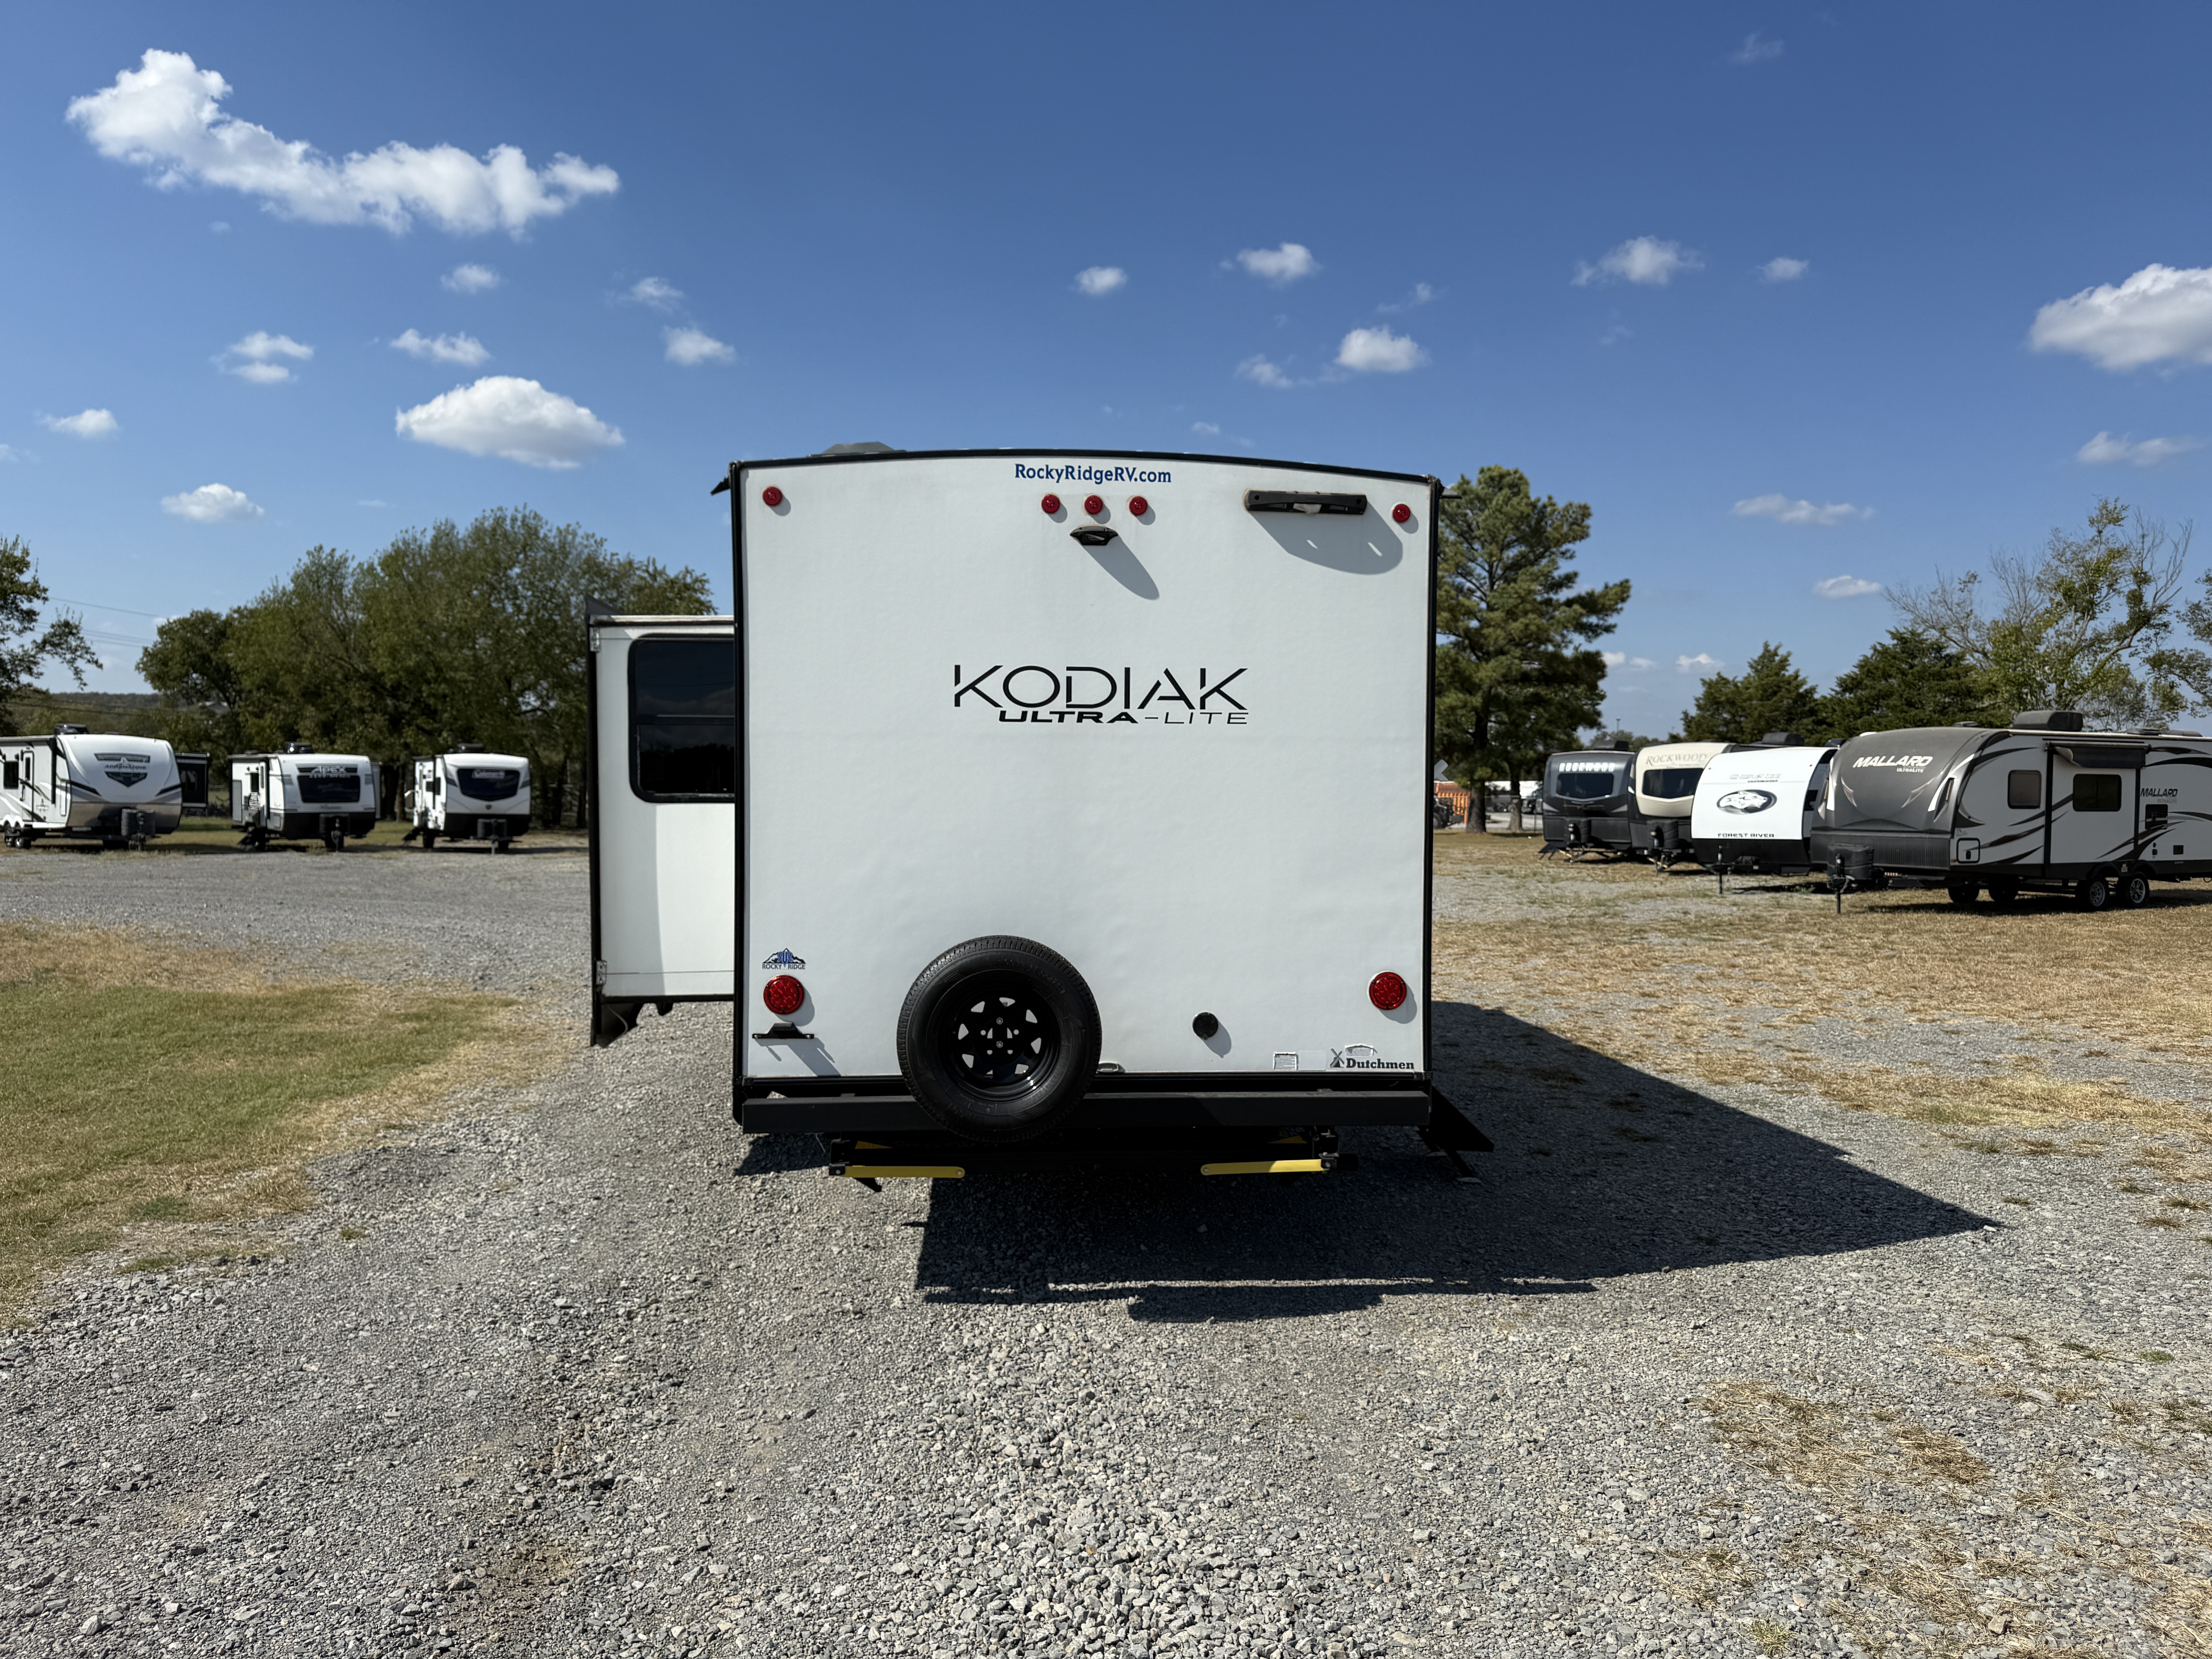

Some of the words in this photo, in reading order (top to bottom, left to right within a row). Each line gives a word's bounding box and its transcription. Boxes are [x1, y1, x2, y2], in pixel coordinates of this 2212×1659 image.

[1015, 464, 1171, 484] RockyRidgeRV.com
[955, 665, 1248, 710] KODIAK
[999, 710, 1249, 724] ULTRA-LITE
[1646, 753, 1707, 766] ROCKWOOD
[1853, 756, 1933, 768] MALLARD
[2140, 788, 2178, 797] MALLARD
[1346, 1058, 1415, 1069] Dutchmen
